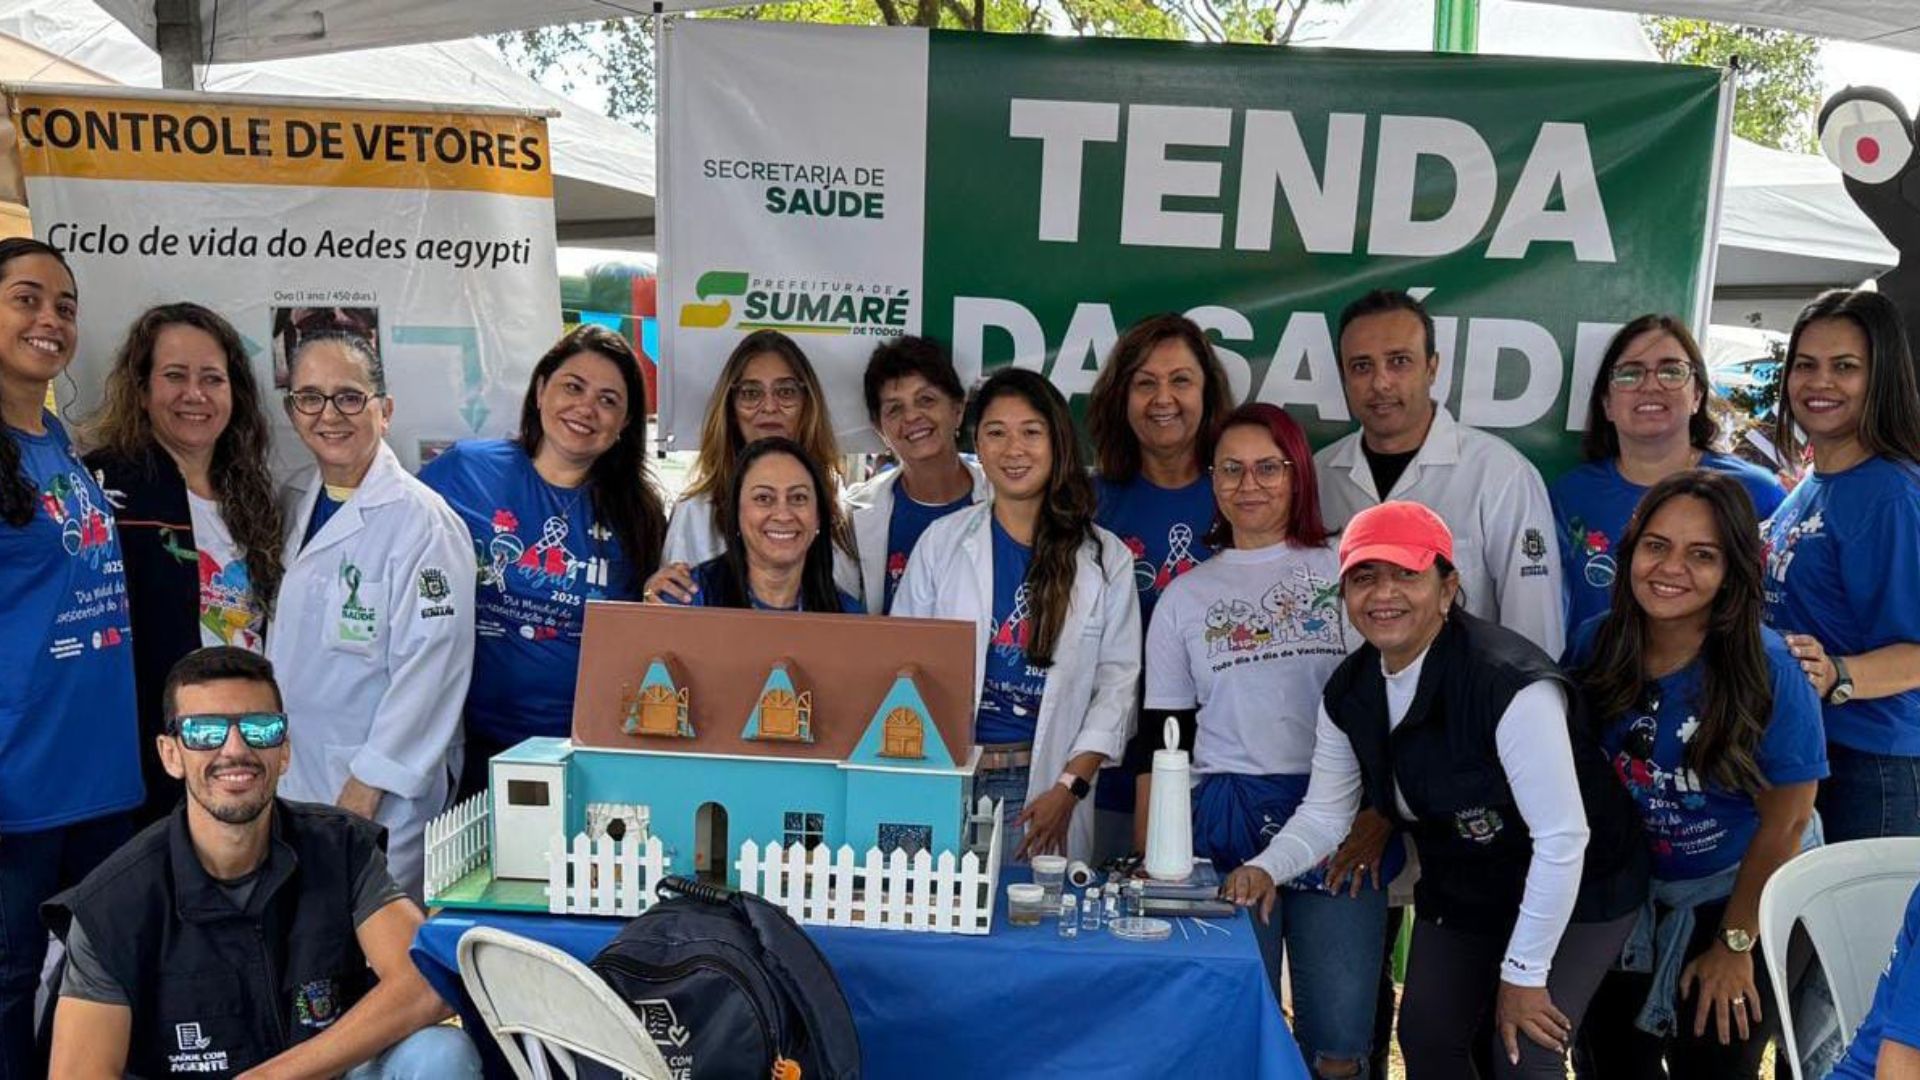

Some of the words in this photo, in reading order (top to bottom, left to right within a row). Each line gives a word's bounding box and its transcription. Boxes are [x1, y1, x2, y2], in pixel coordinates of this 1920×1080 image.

[20, 107, 273, 157] CONTROLE
[285, 121, 344, 160] DE
[352, 123, 542, 172] VETORES
[703, 159, 848, 186] SECRETARIA
[854, 168, 885, 187] DE
[1009, 98, 1616, 262] TENDA
[765, 185, 885, 219] SAÚDE
[48, 223, 129, 255] Ciclo
[138, 226, 179, 256] de
[189, 227, 258, 257] vida
[267, 228, 307, 259] do
[314, 229, 407, 260] Aedes
[415, 238, 531, 269] aegypti
[753, 278, 865, 294] PREFEITURA
[872, 285, 895, 295] DE
[273, 290, 294, 301] Ovo
[744, 289, 909, 326] SUMARÉ
[853, 327, 867, 336] DE
[869, 327, 905, 338] TODOS
[951, 296, 1119, 404] DA
[550, 589, 580, 606] 2025
[1280, 649, 1294, 658] de
[1648, 798, 1680, 811] 2025
[202, 1050, 227, 1061] COM
[669, 1054, 693, 1067] COM
[170, 1060, 230, 1073] AGENTE
